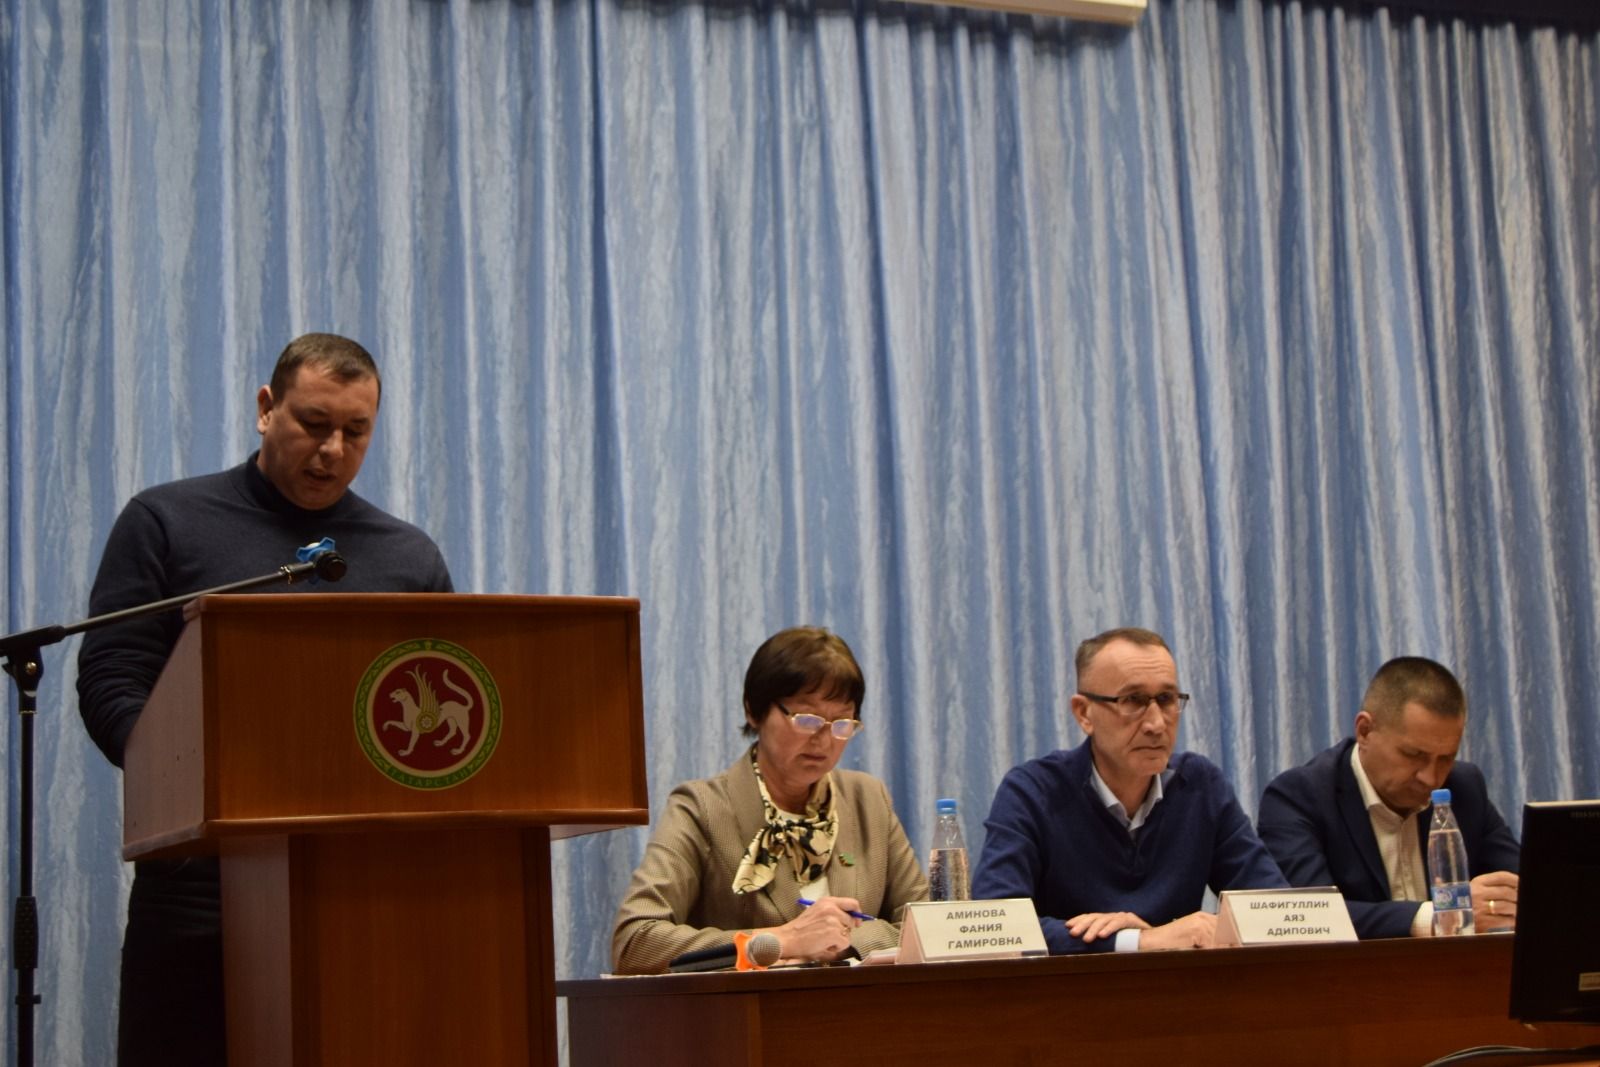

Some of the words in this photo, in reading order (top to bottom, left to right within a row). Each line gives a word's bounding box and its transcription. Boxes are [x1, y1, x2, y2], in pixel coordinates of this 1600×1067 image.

[1250, 901, 1329, 910] ШАФИГУЛЛИН
[947, 909, 1006, 920] АМИНОВА
[1283, 914, 1305, 922] АЯЗ
[960, 923, 1002, 933] ФАНИЯ
[1267, 927, 1330, 936] АДИПОВИЧ
[948, 937, 1022, 949] ГАМИРОВНА
